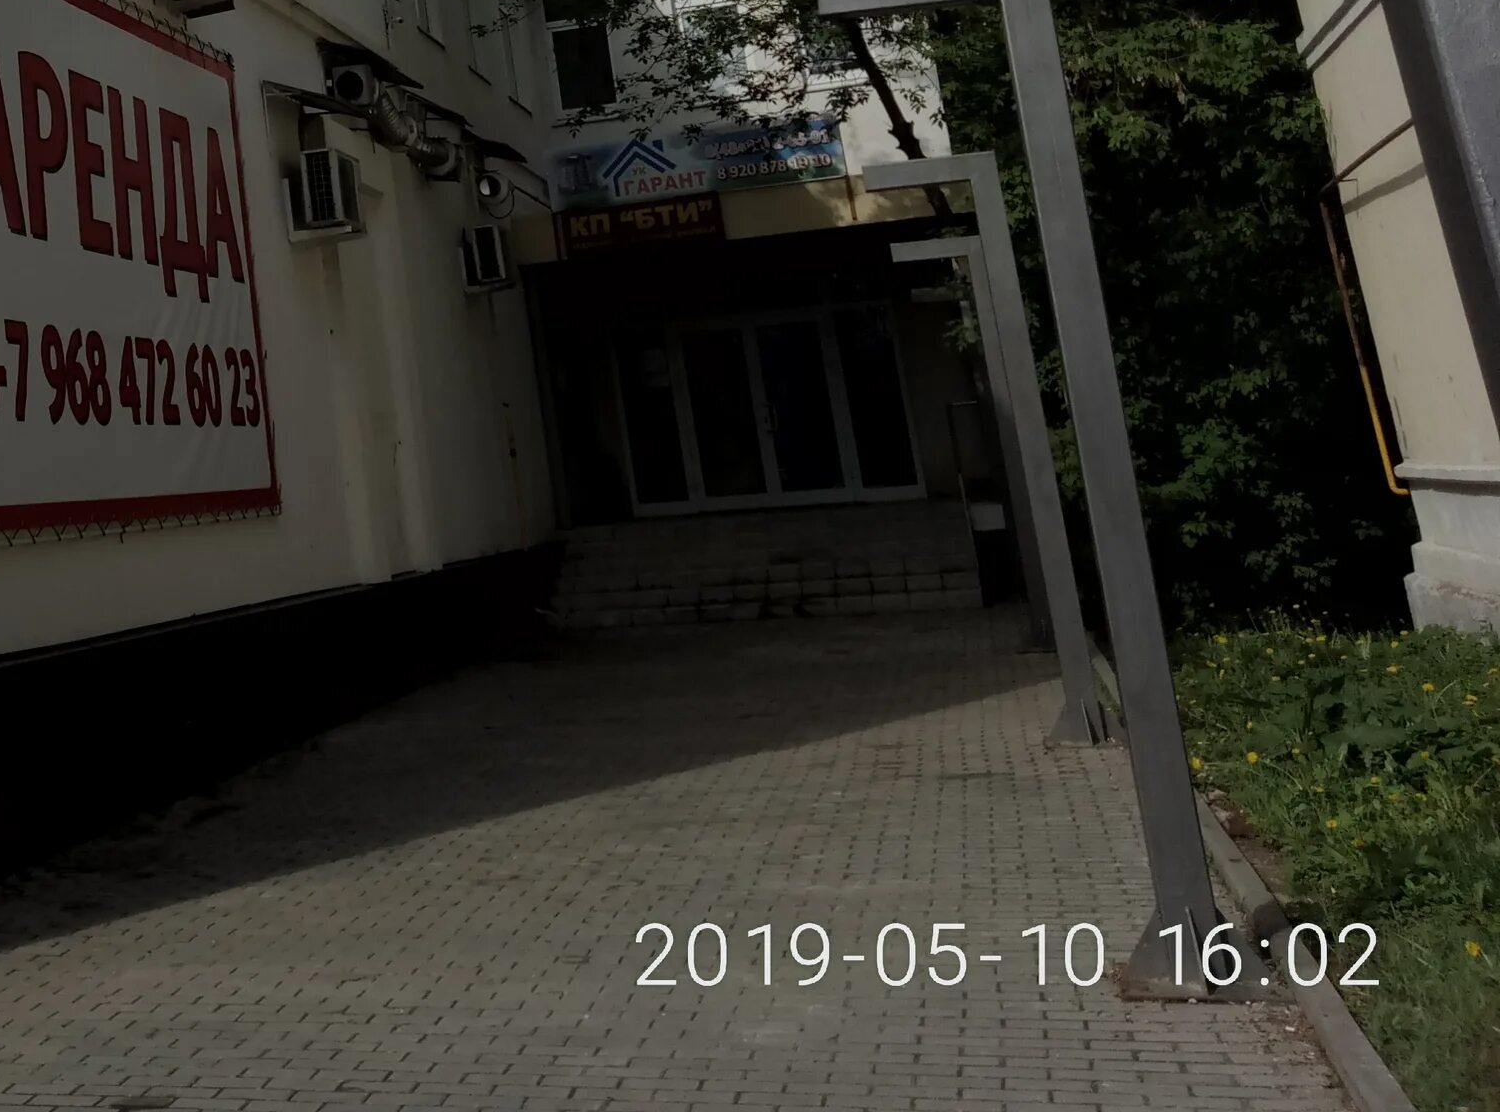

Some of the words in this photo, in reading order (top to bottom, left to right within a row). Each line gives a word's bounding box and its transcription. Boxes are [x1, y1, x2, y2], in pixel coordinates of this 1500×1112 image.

[623, 170, 706, 196] ГАРАНТ
[631, 166, 646, 176] УК
[729, 163, 756, 178] 920
[570, 212, 611, 238] КП
[41, 324, 112, 426] 968
[119, 336, 181, 426] 472
[185, 342, 223, 428] 60
[225, 347, 261, 427] 23
